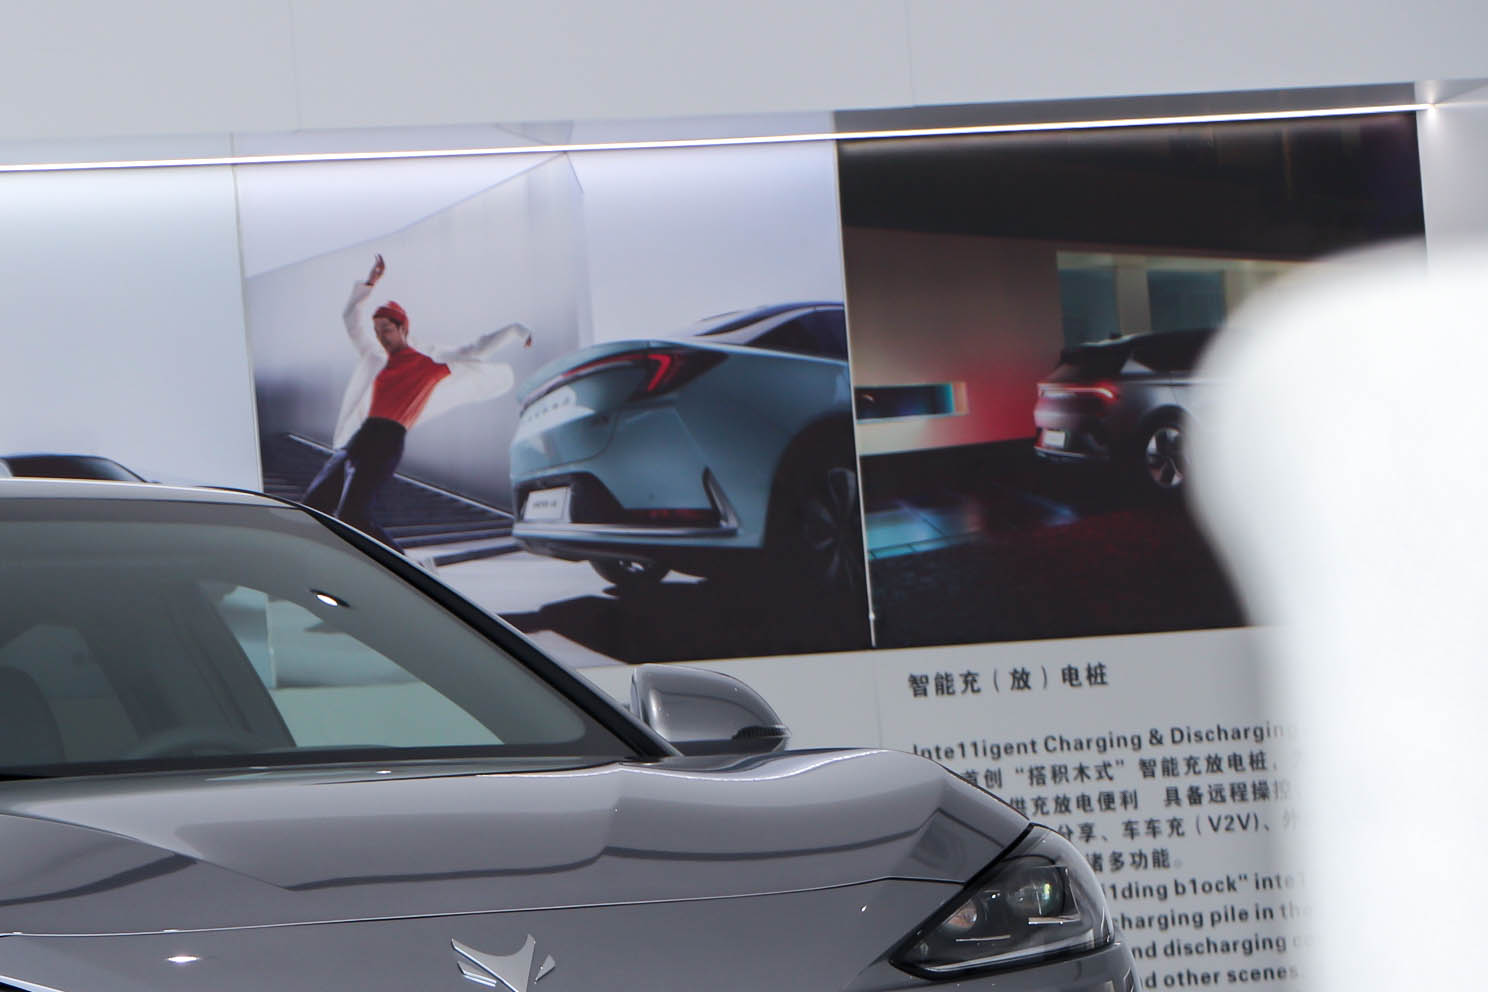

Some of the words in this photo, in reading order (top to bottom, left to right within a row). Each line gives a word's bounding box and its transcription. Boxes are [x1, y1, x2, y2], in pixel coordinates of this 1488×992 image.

[908, 662, 1108, 698] 智能充（放）电桩
[1044, 729, 1142, 755] Charging
[1148, 728, 1164, 746] &
[1170, 720, 1296, 746] Dischargin
[1211, 905, 1249, 926] pile
[1255, 903, 1274, 921] in
[1164, 933, 1287, 957] discharging
[1164, 968, 1221, 988] other
